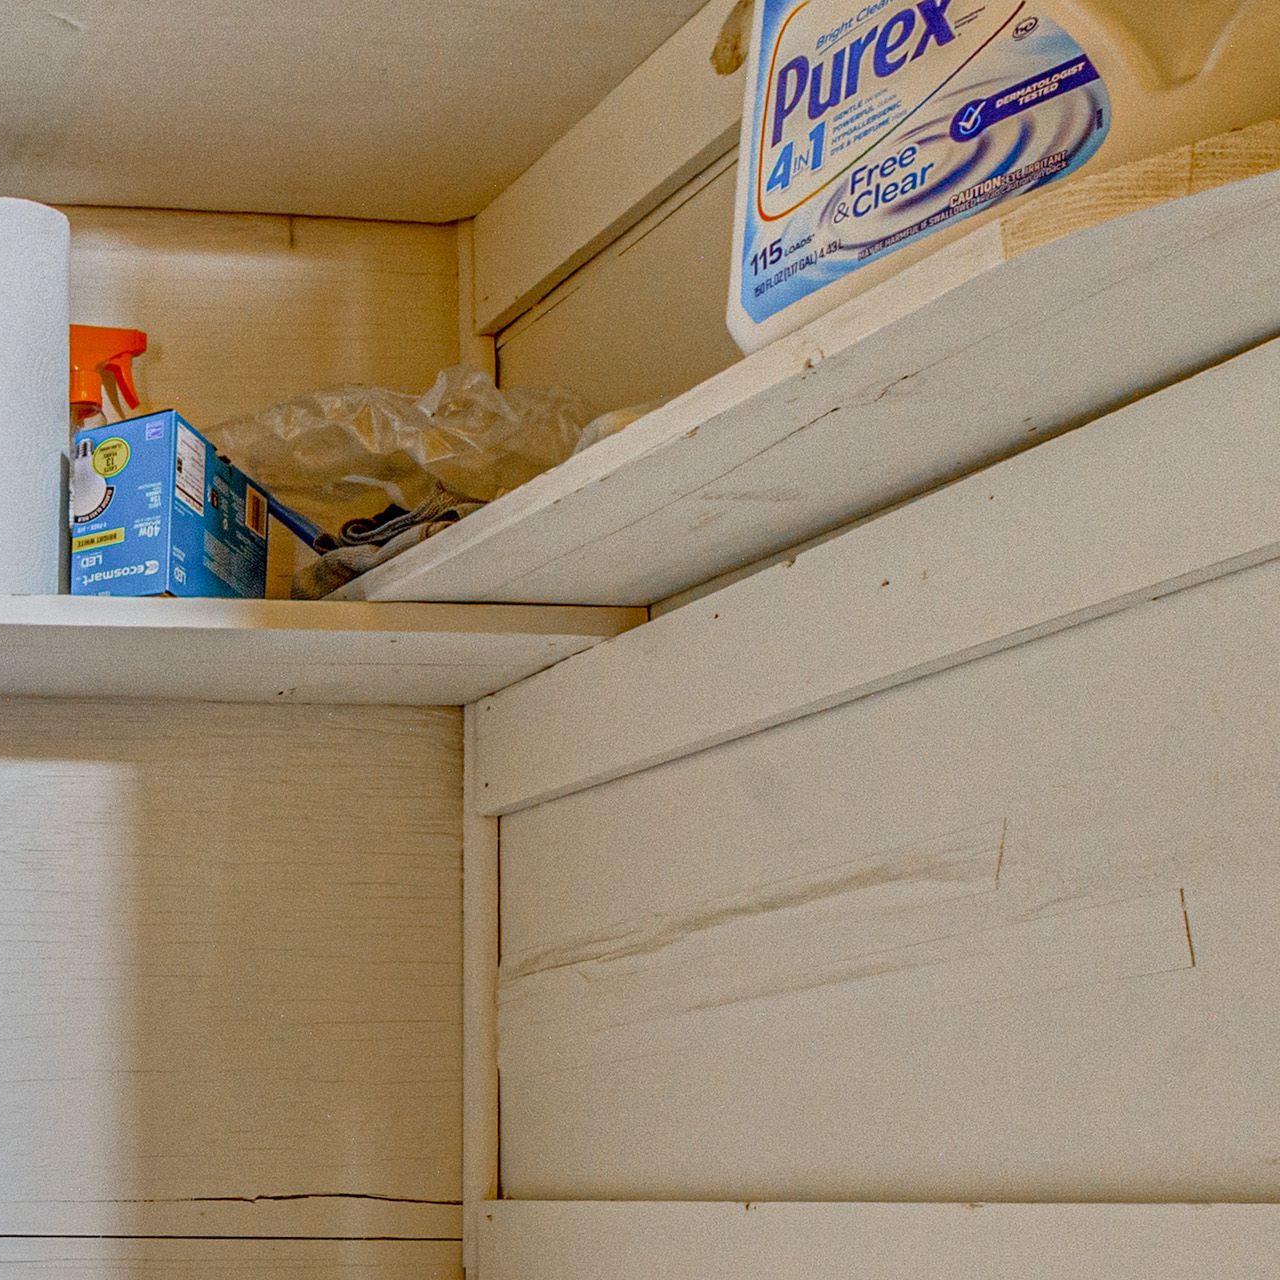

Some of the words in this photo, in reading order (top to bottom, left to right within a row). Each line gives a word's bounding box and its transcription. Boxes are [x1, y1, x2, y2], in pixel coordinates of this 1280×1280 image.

[816, 18, 853, 49] Bright
[771, 0, 955, 148] Purex
[995, 62, 1086, 109] DERMATOLOGIST
[1019, 83, 1058, 106] TESTED
[766, 142, 793, 193] 4
[793, 149, 810, 176] IN
[808, 119, 828, 172] 1
[850, 145, 917, 196] Free
[834, 202, 850, 224] &
[852, 162, 935, 217] Clear
[750, 238, 783, 276] 115
[77, 537, 95, 549] WHITE
[95, 532, 117, 545] BRIGHT
[80, 554, 103, 568] LED
[82, 564, 145, 586] ecosmart
